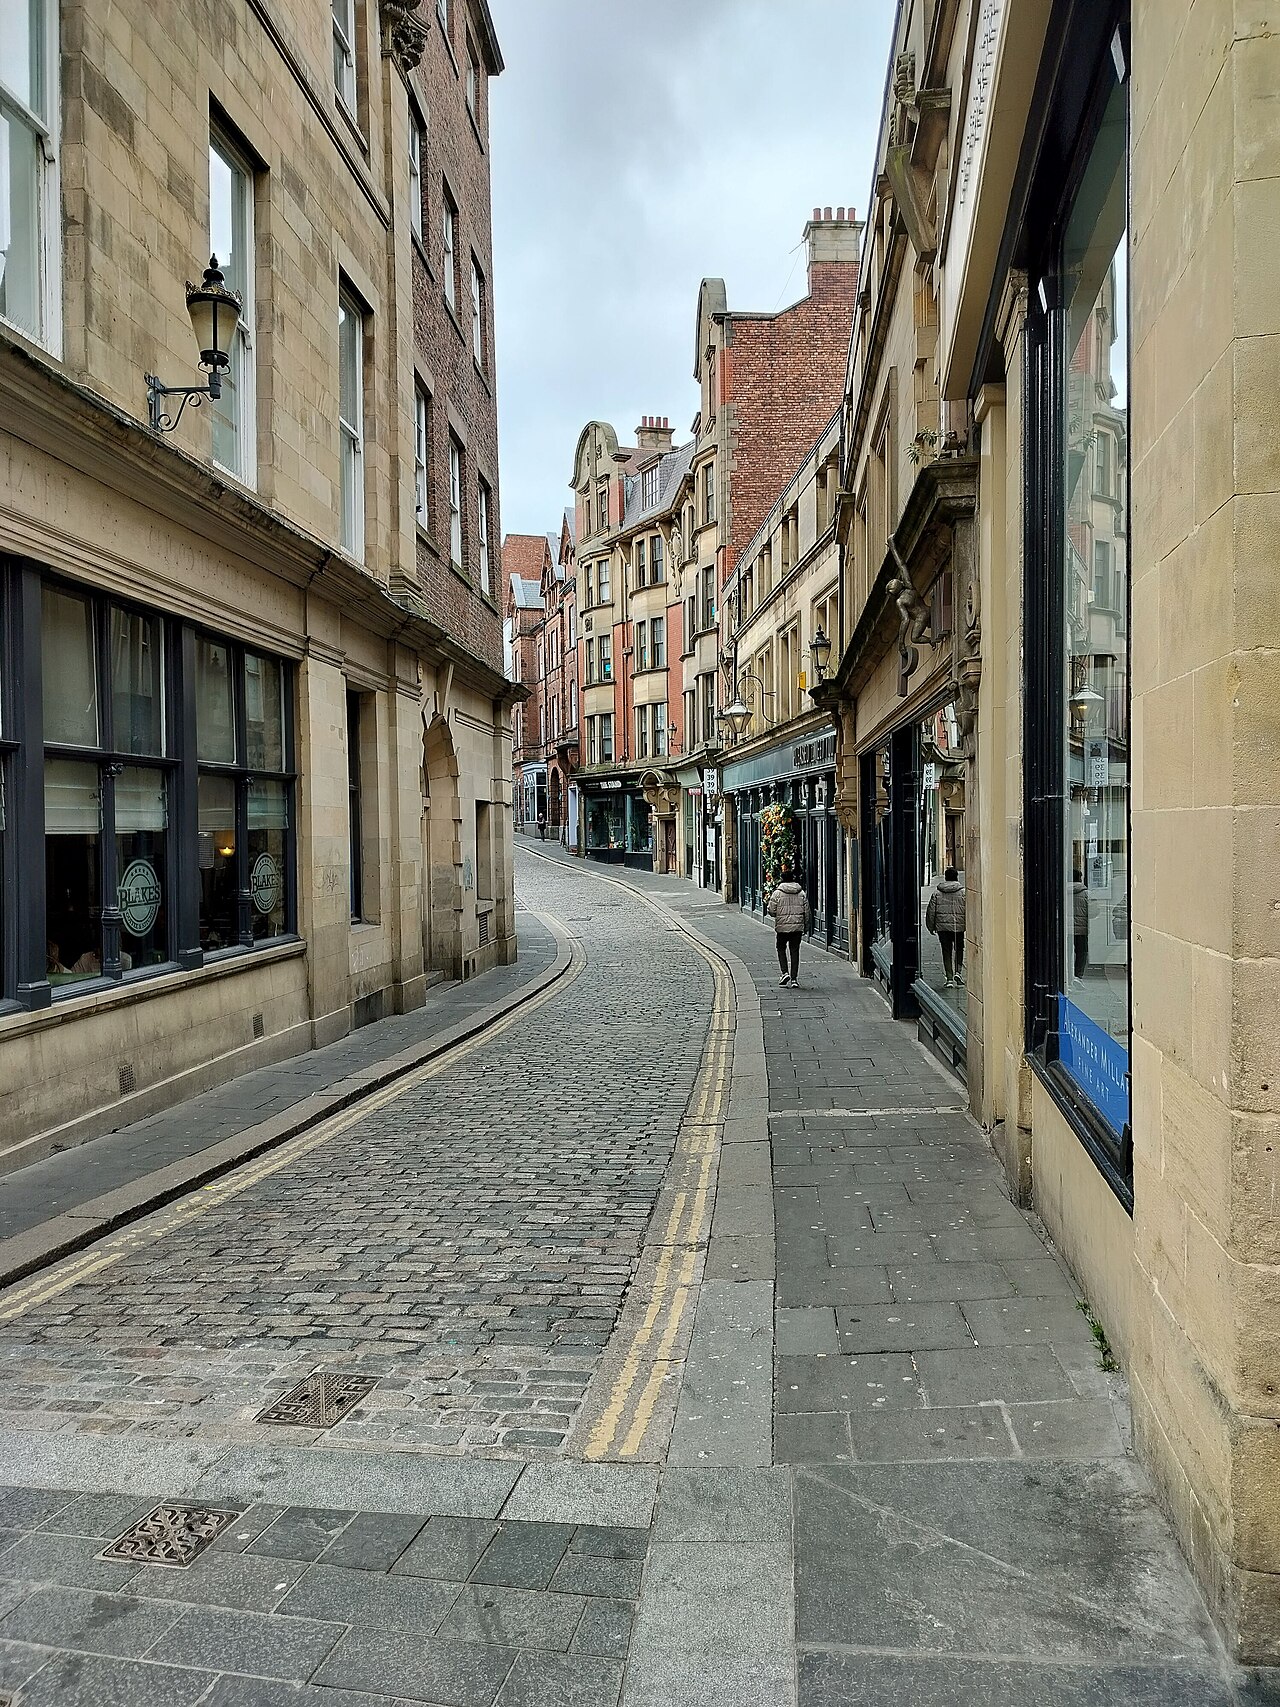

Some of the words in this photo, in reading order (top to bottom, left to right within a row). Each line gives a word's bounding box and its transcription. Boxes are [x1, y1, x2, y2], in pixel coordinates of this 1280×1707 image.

[118, 885, 160, 912] BLAKES
[252, 873, 281, 894] BLAKES
[1064, 1011, 1098, 1063] ALEXANDER
[1078, 1056, 1093, 1084] FINE
[1096, 1077, 1110, 1102] ART
